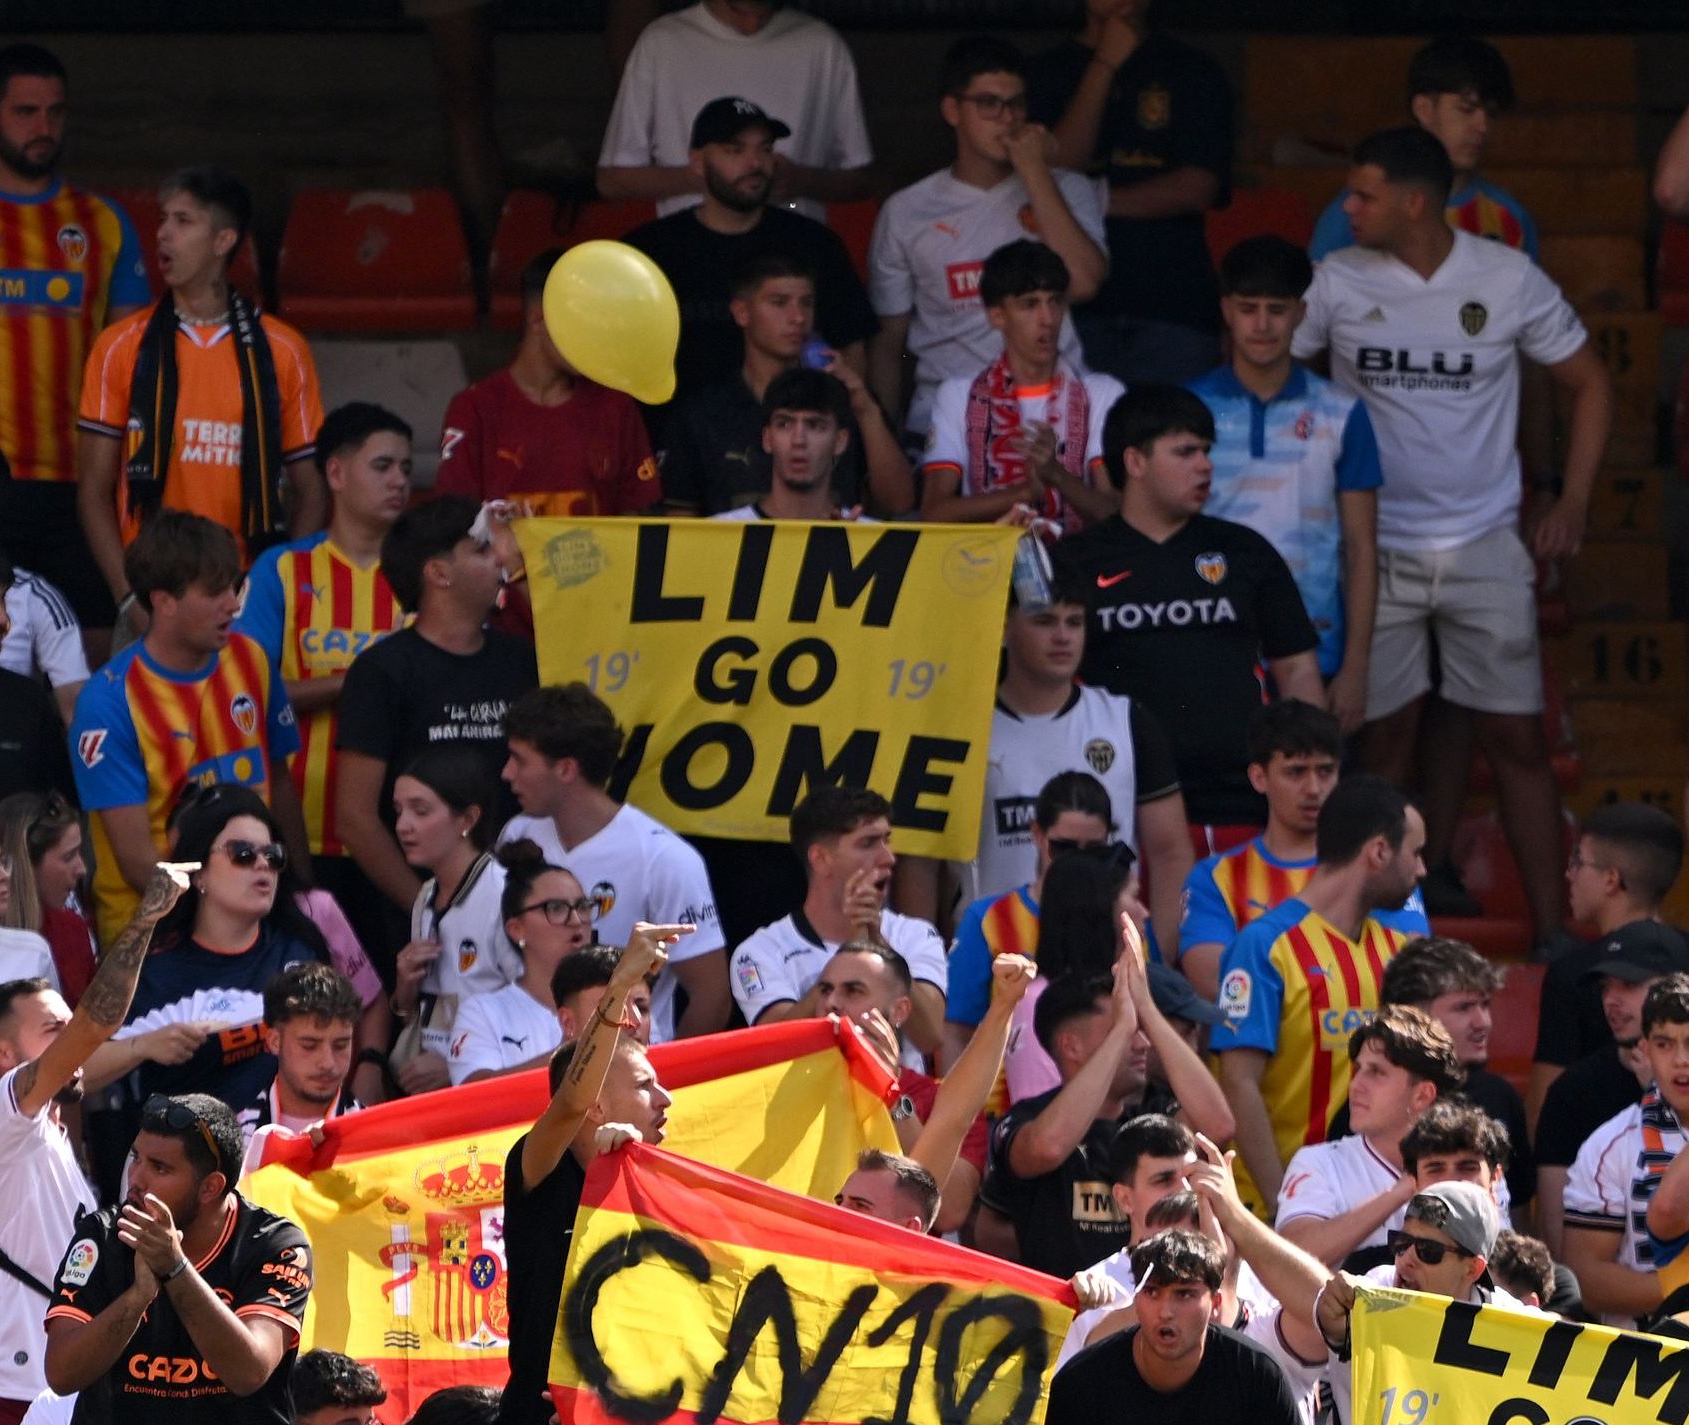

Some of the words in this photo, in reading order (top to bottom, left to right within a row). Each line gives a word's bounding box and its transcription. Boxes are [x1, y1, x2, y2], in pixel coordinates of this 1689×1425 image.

[1356, 346, 1473, 376] BLU
[629, 522, 922, 628] LIM
[1097, 598, 1236, 632] TOYOTA
[694, 636, 838, 708] GO
[1000, 805, 1036, 827] TM
[1081, 1192, 1112, 1212] TM
